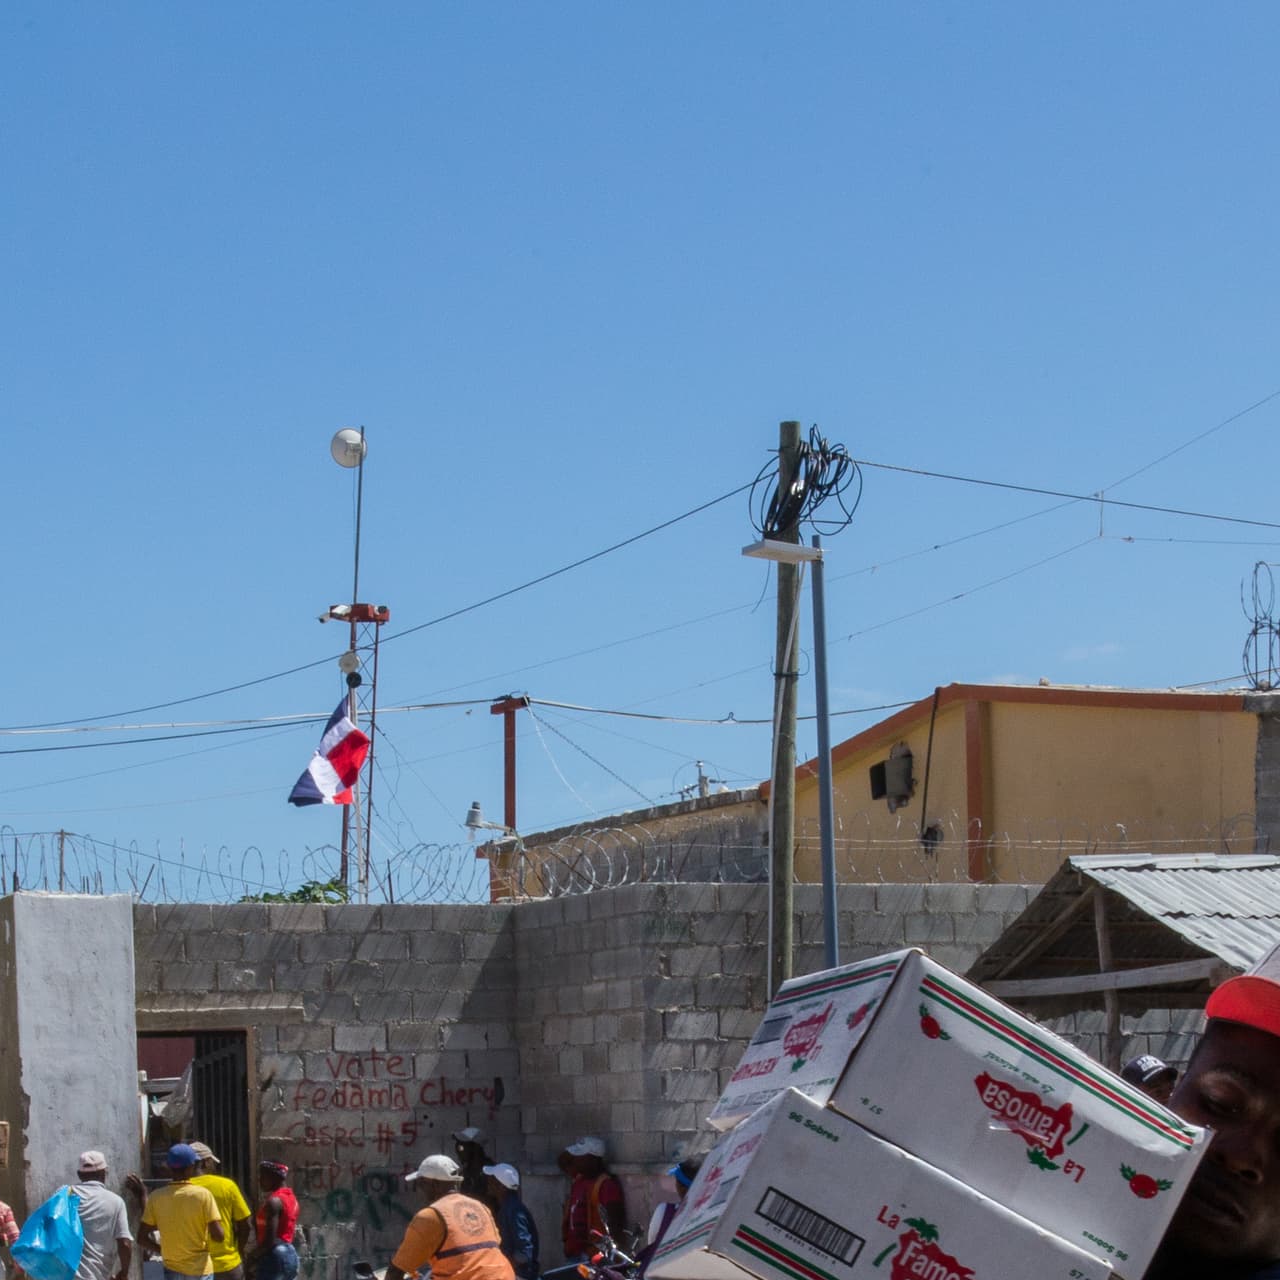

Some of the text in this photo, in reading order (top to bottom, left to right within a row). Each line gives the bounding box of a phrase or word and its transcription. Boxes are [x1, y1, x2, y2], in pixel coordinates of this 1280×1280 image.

[982, 1051, 1019, 1073] natural
[788, 1111, 839, 1142] 96 Sobres
[983, 1082, 1086, 1183] La Famosa
[877, 1205, 900, 1229] La
[1082, 1230, 1115, 1254] Sobres
